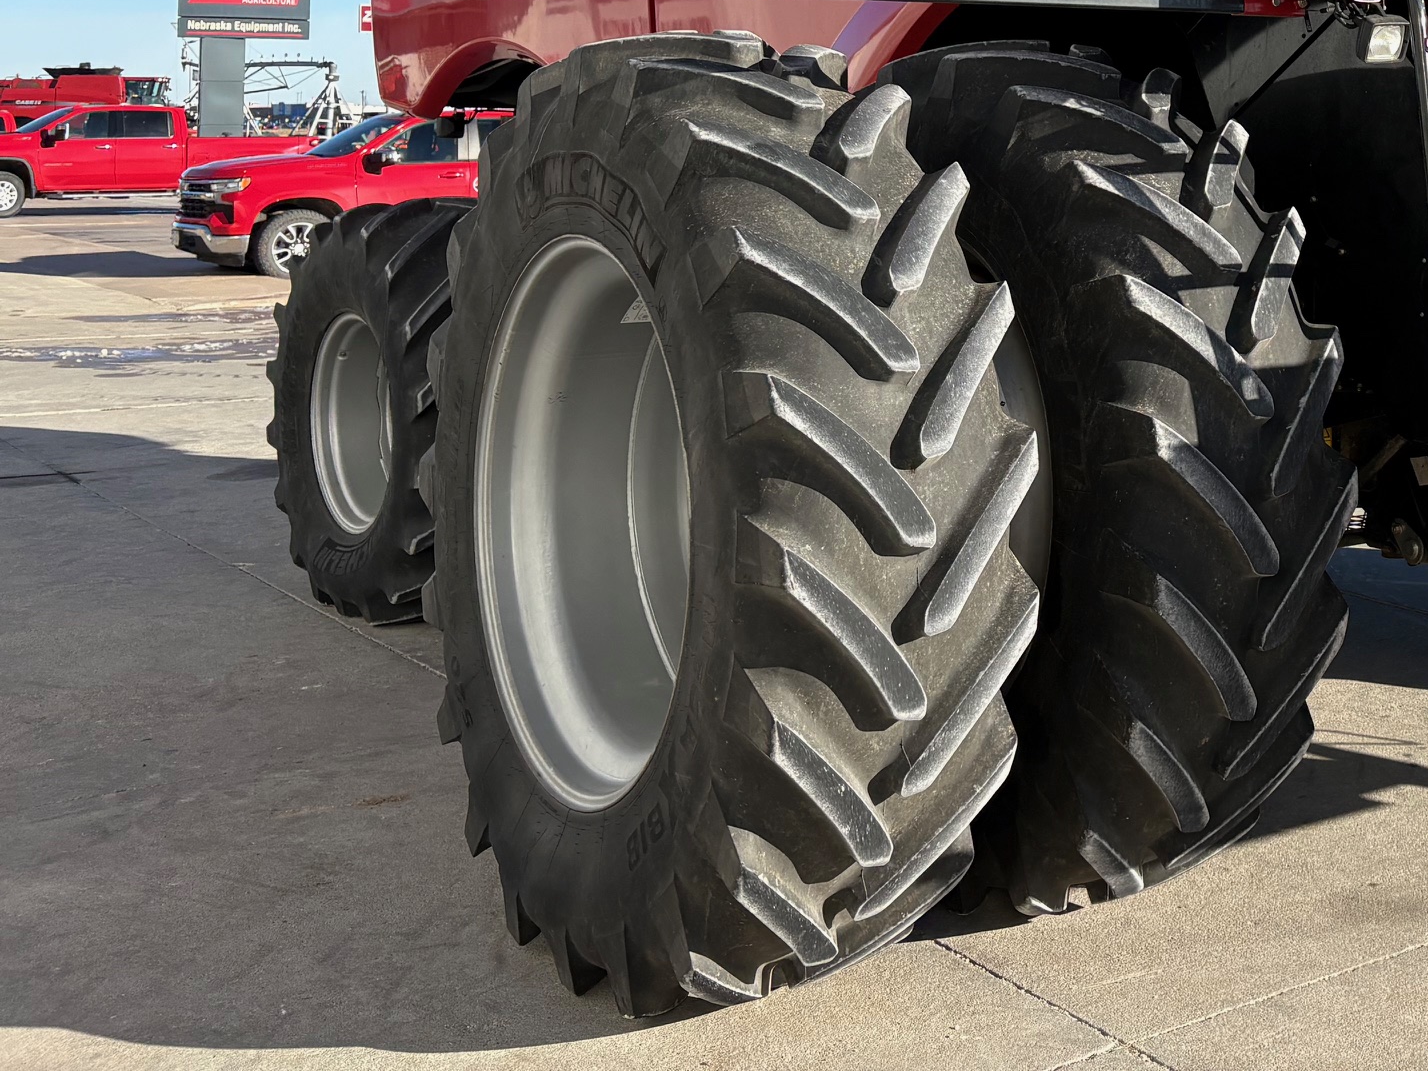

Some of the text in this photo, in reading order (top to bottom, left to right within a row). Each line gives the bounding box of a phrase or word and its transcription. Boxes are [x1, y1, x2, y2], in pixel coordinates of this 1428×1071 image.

[187, 19, 302, 33] Nebraska Equipment Inc.
